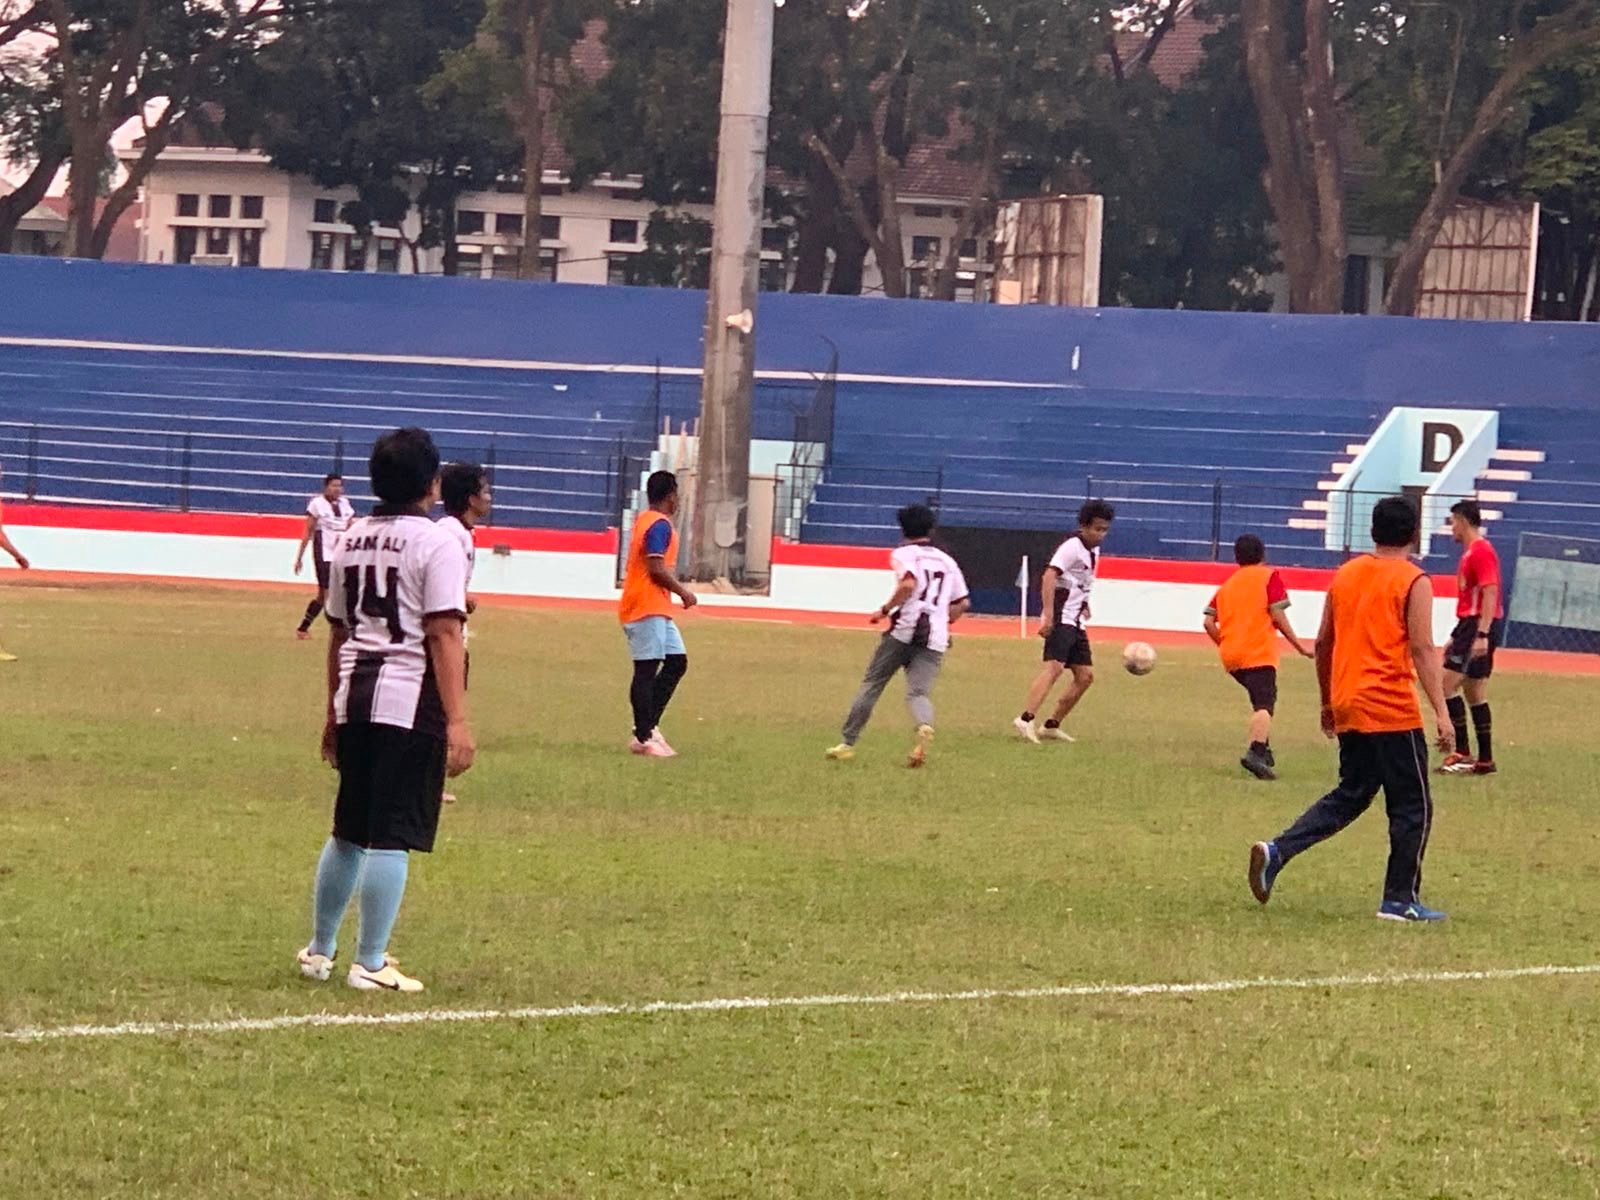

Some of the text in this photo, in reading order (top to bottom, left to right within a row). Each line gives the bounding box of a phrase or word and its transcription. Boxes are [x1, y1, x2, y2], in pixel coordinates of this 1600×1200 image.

[1421, 421, 1464, 473] D
[344, 565, 405, 643] 14
[920, 569, 945, 606] 17
